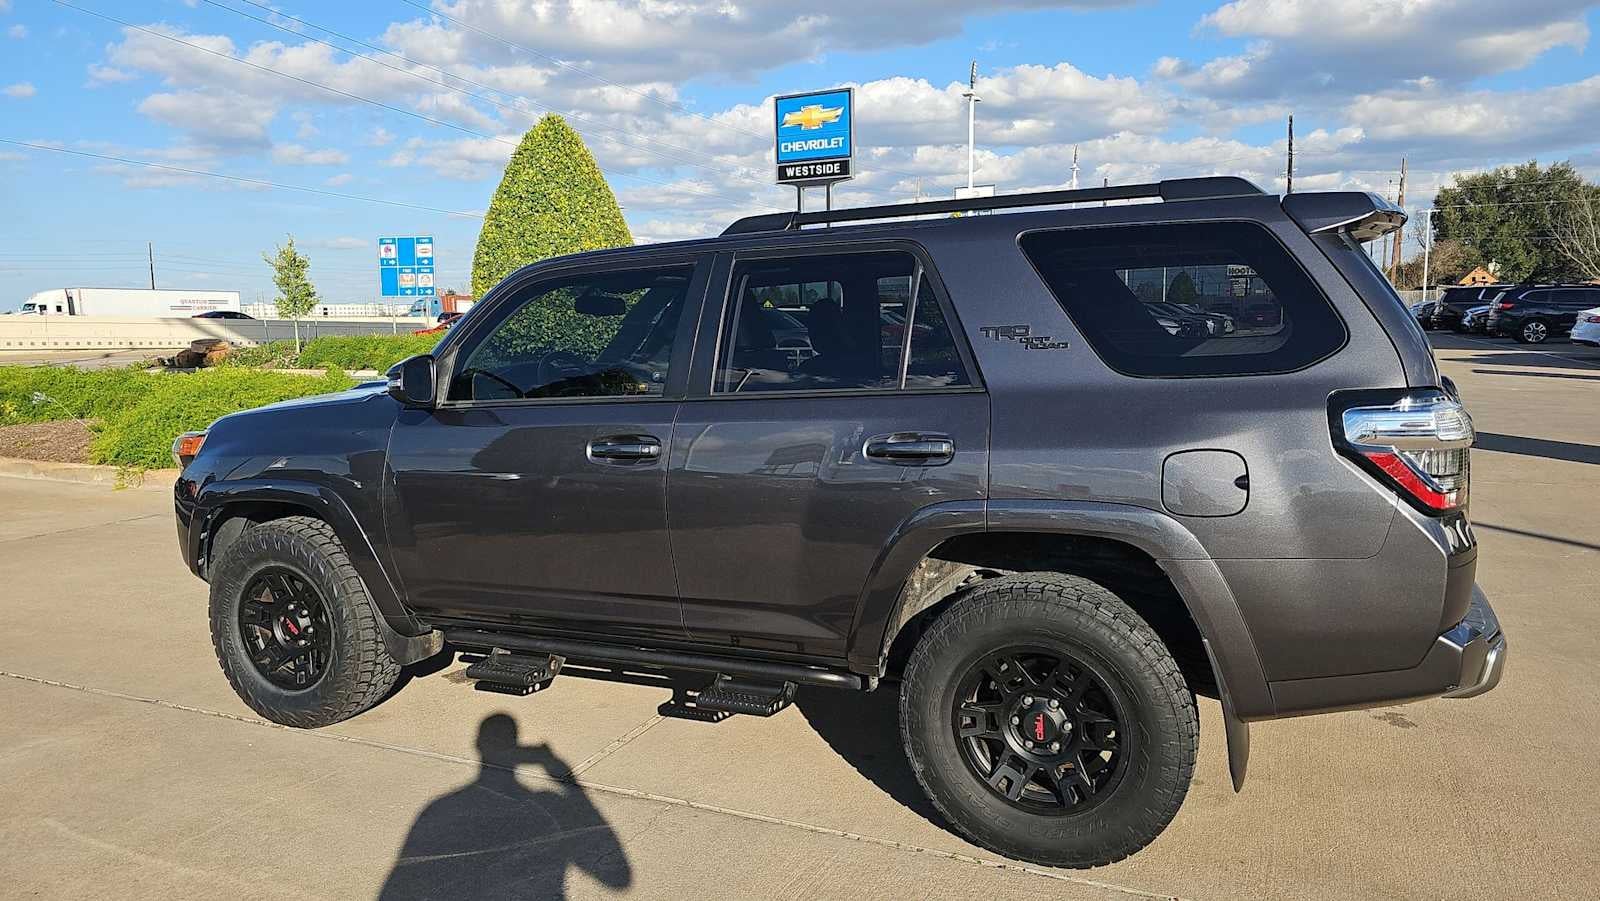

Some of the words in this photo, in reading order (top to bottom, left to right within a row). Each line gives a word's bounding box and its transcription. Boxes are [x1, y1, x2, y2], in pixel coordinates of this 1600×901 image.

[781, 137, 844, 153] CHEVROLET
[786, 163, 840, 177] WESTSIDE
[980, 325, 1030, 341] TRD
[1034, 714, 1044, 740] TRD
